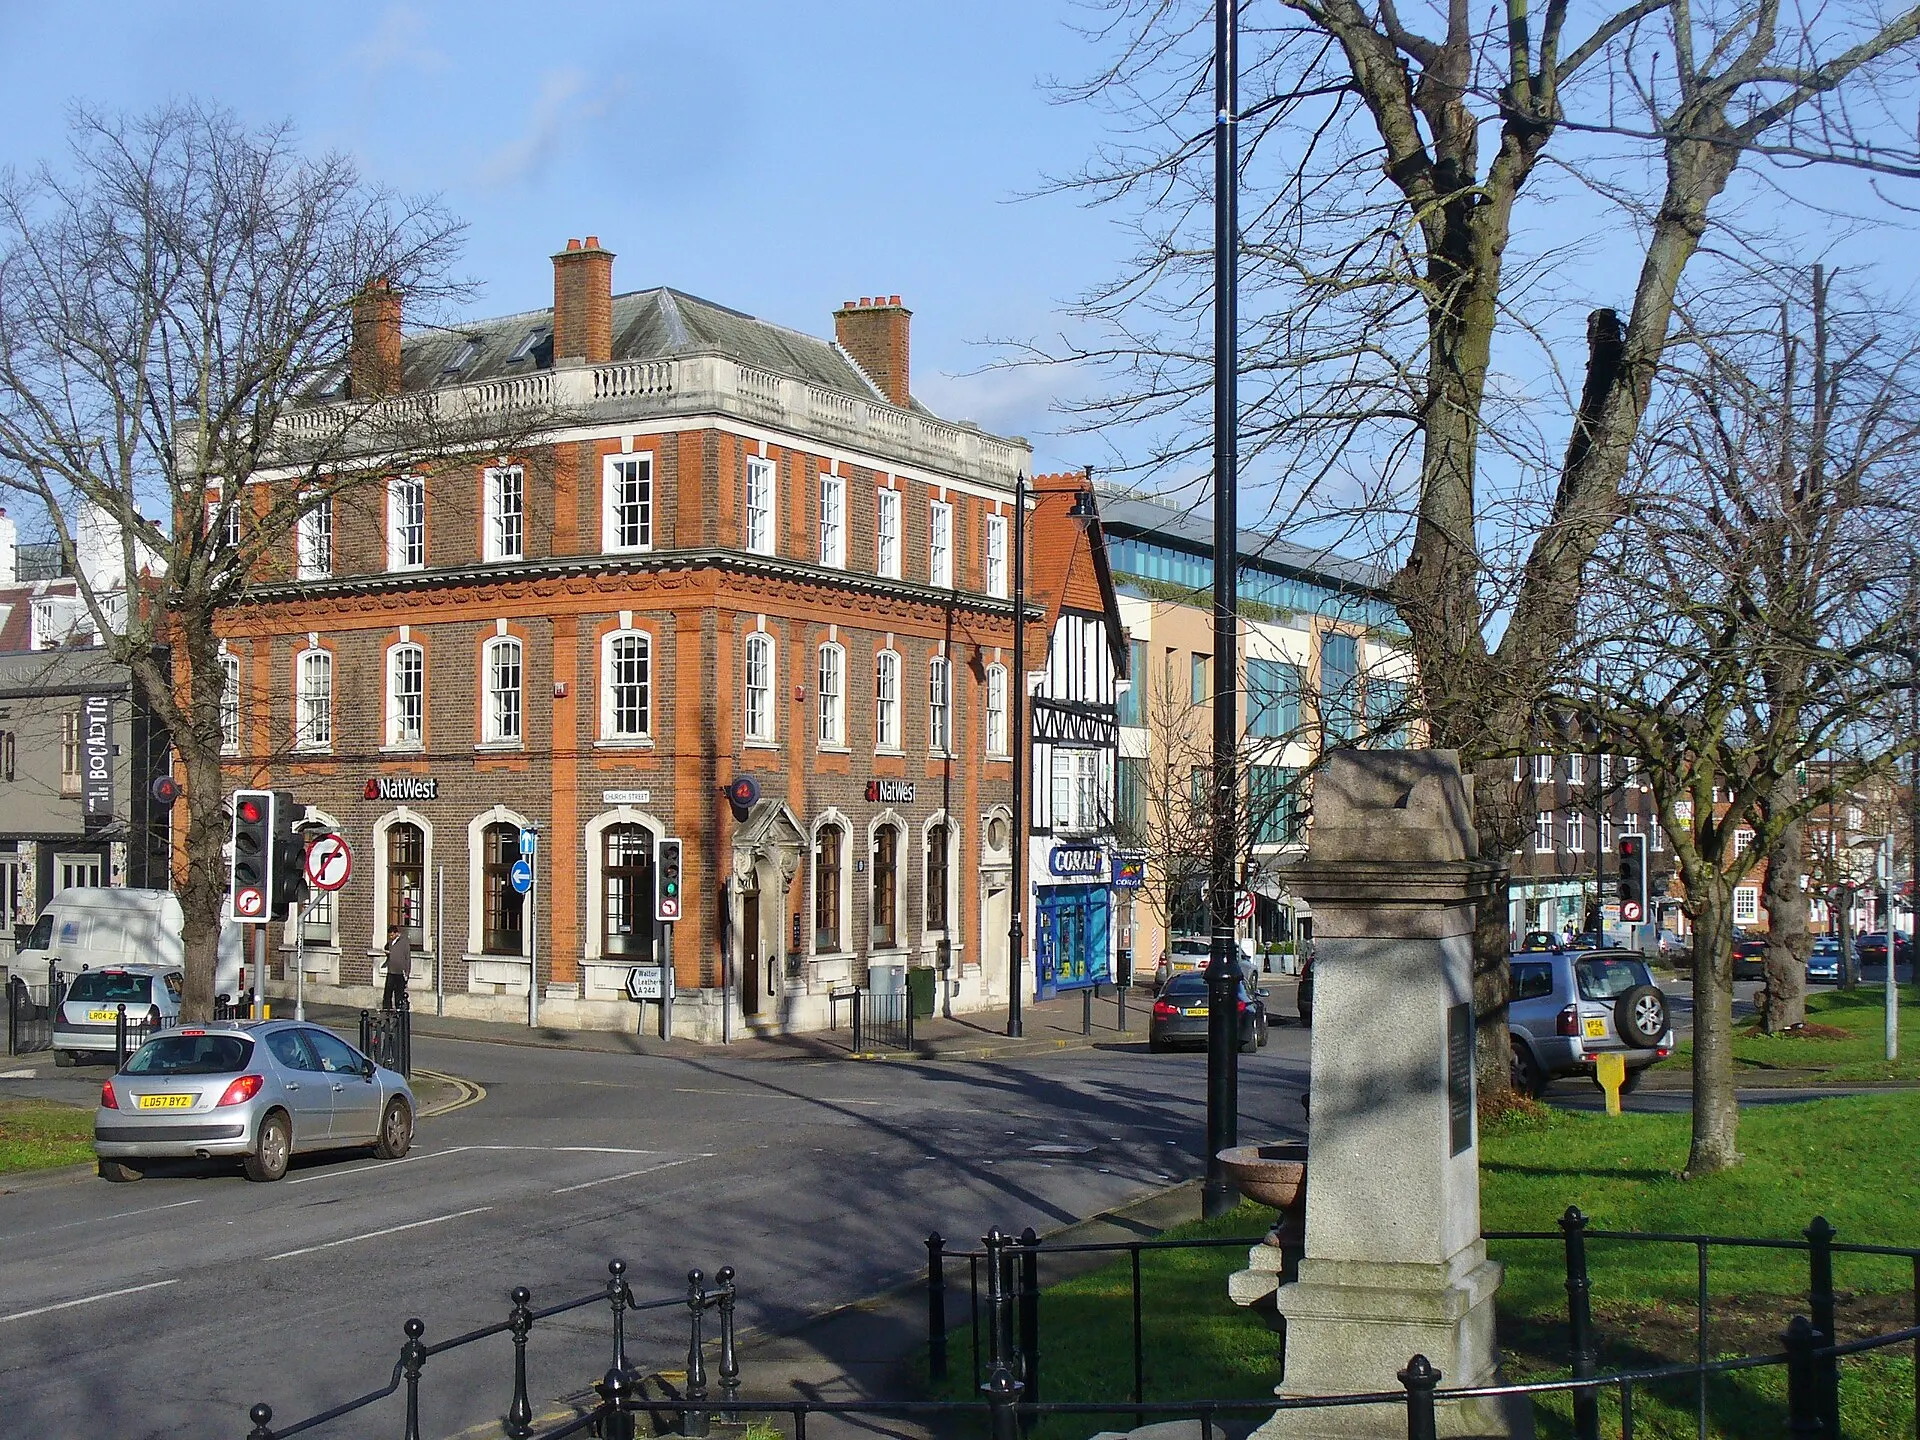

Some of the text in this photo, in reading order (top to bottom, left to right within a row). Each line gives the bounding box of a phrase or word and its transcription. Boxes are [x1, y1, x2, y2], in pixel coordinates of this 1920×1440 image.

[87, 697, 108, 779] BOCADITO
[380, 778, 436, 799] NatWest
[605, 793, 648, 801] CHURCH STREET
[880, 780, 916, 801] NatWest
[1054, 850, 1096, 872] CORAL
[143, 1096, 188, 1107] LD57 BYZ
